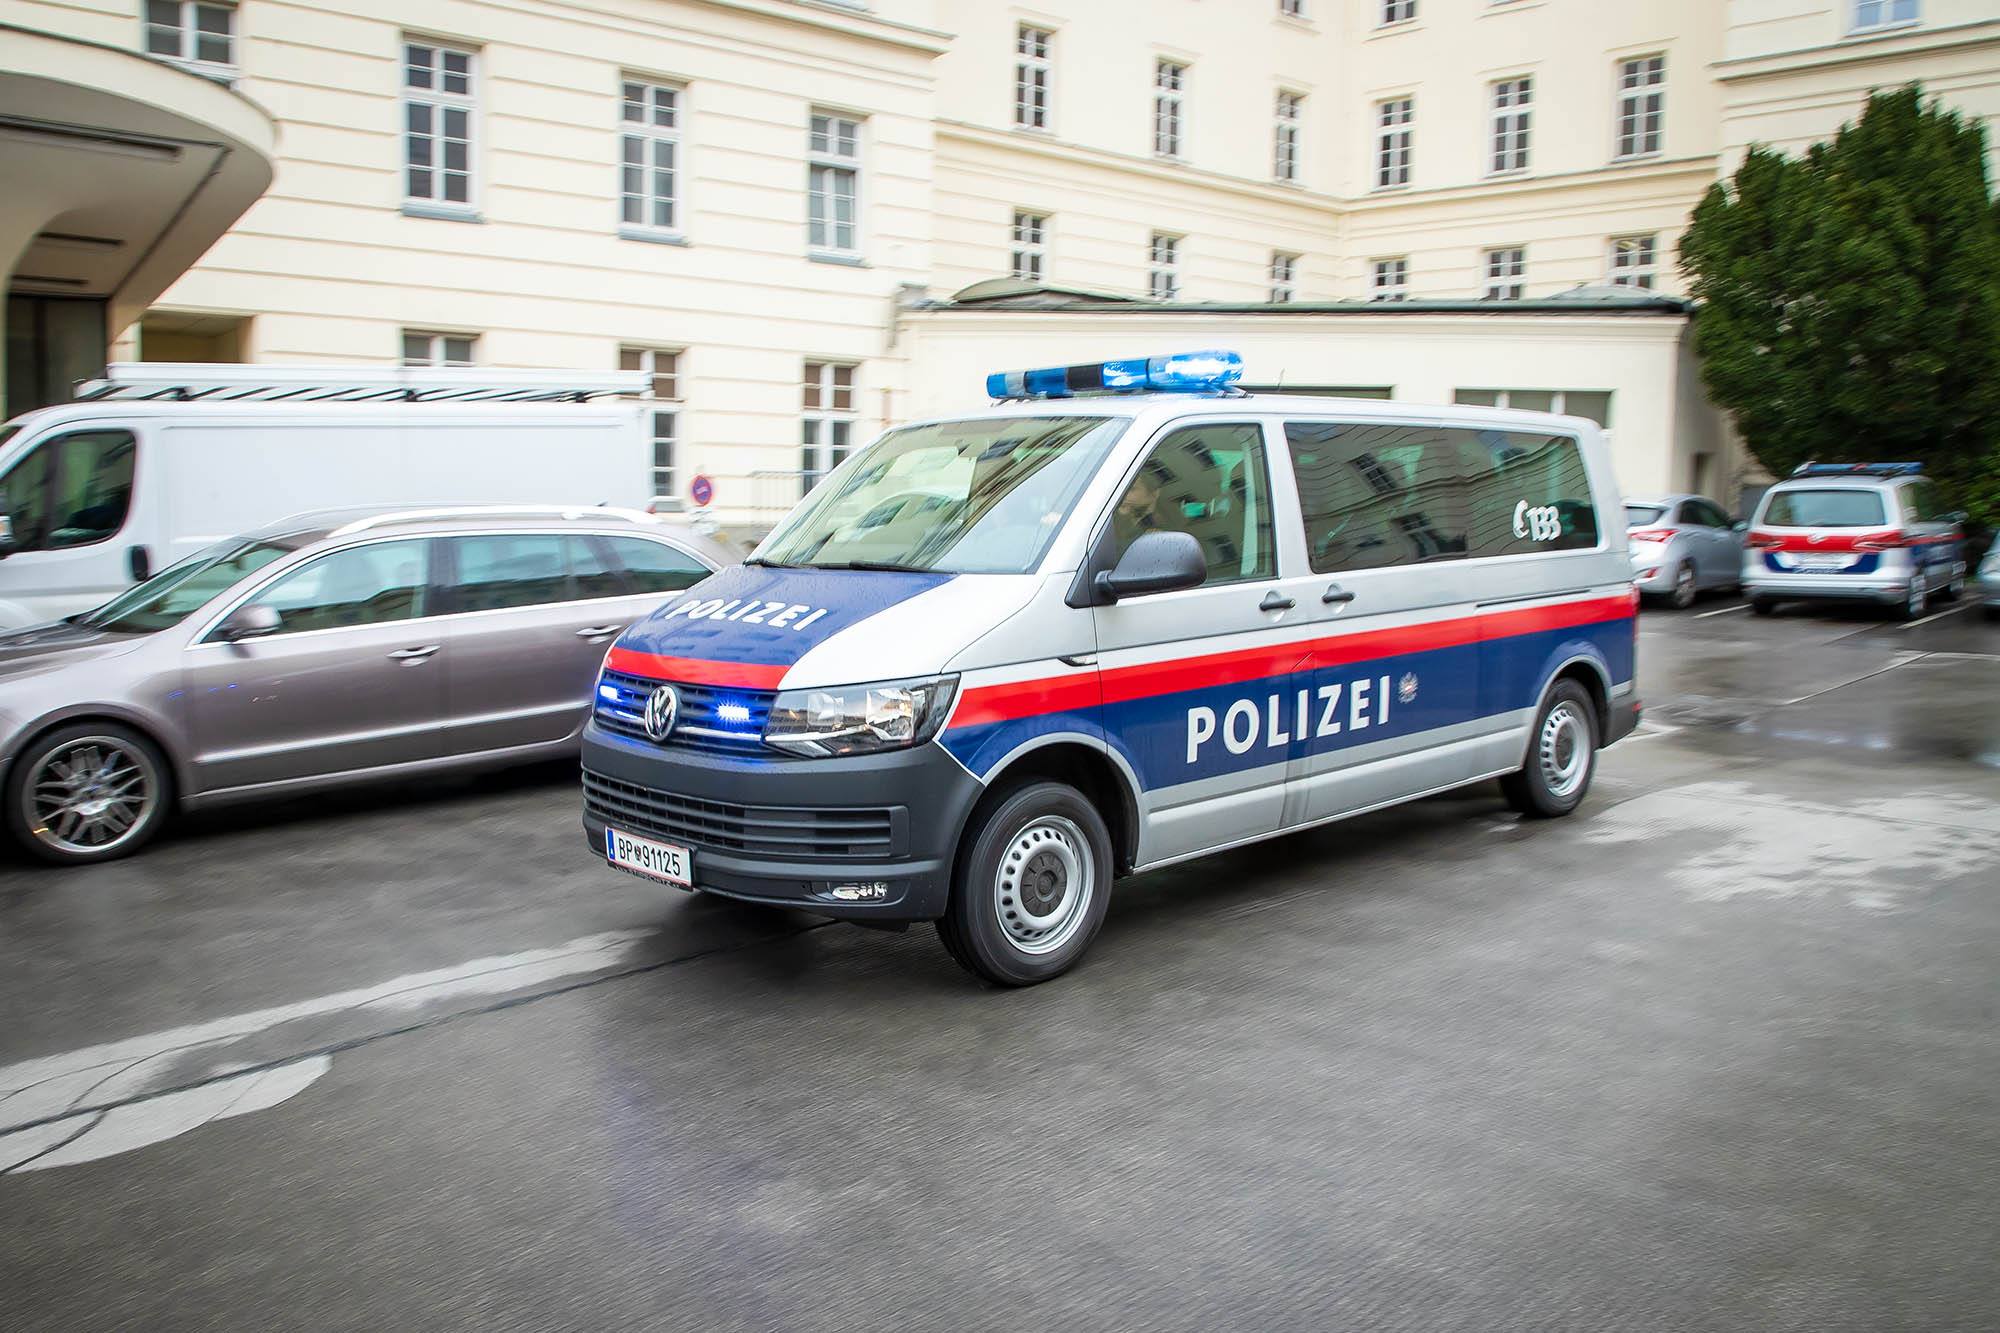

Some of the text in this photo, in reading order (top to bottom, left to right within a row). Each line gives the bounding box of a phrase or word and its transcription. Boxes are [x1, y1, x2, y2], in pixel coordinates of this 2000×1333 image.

[1525, 506, 1561, 541] 133
[665, 598, 828, 631] POLIZEI
[1186, 675, 1391, 764] POLIZEI
[618, 837, 681, 876] BP 91125
